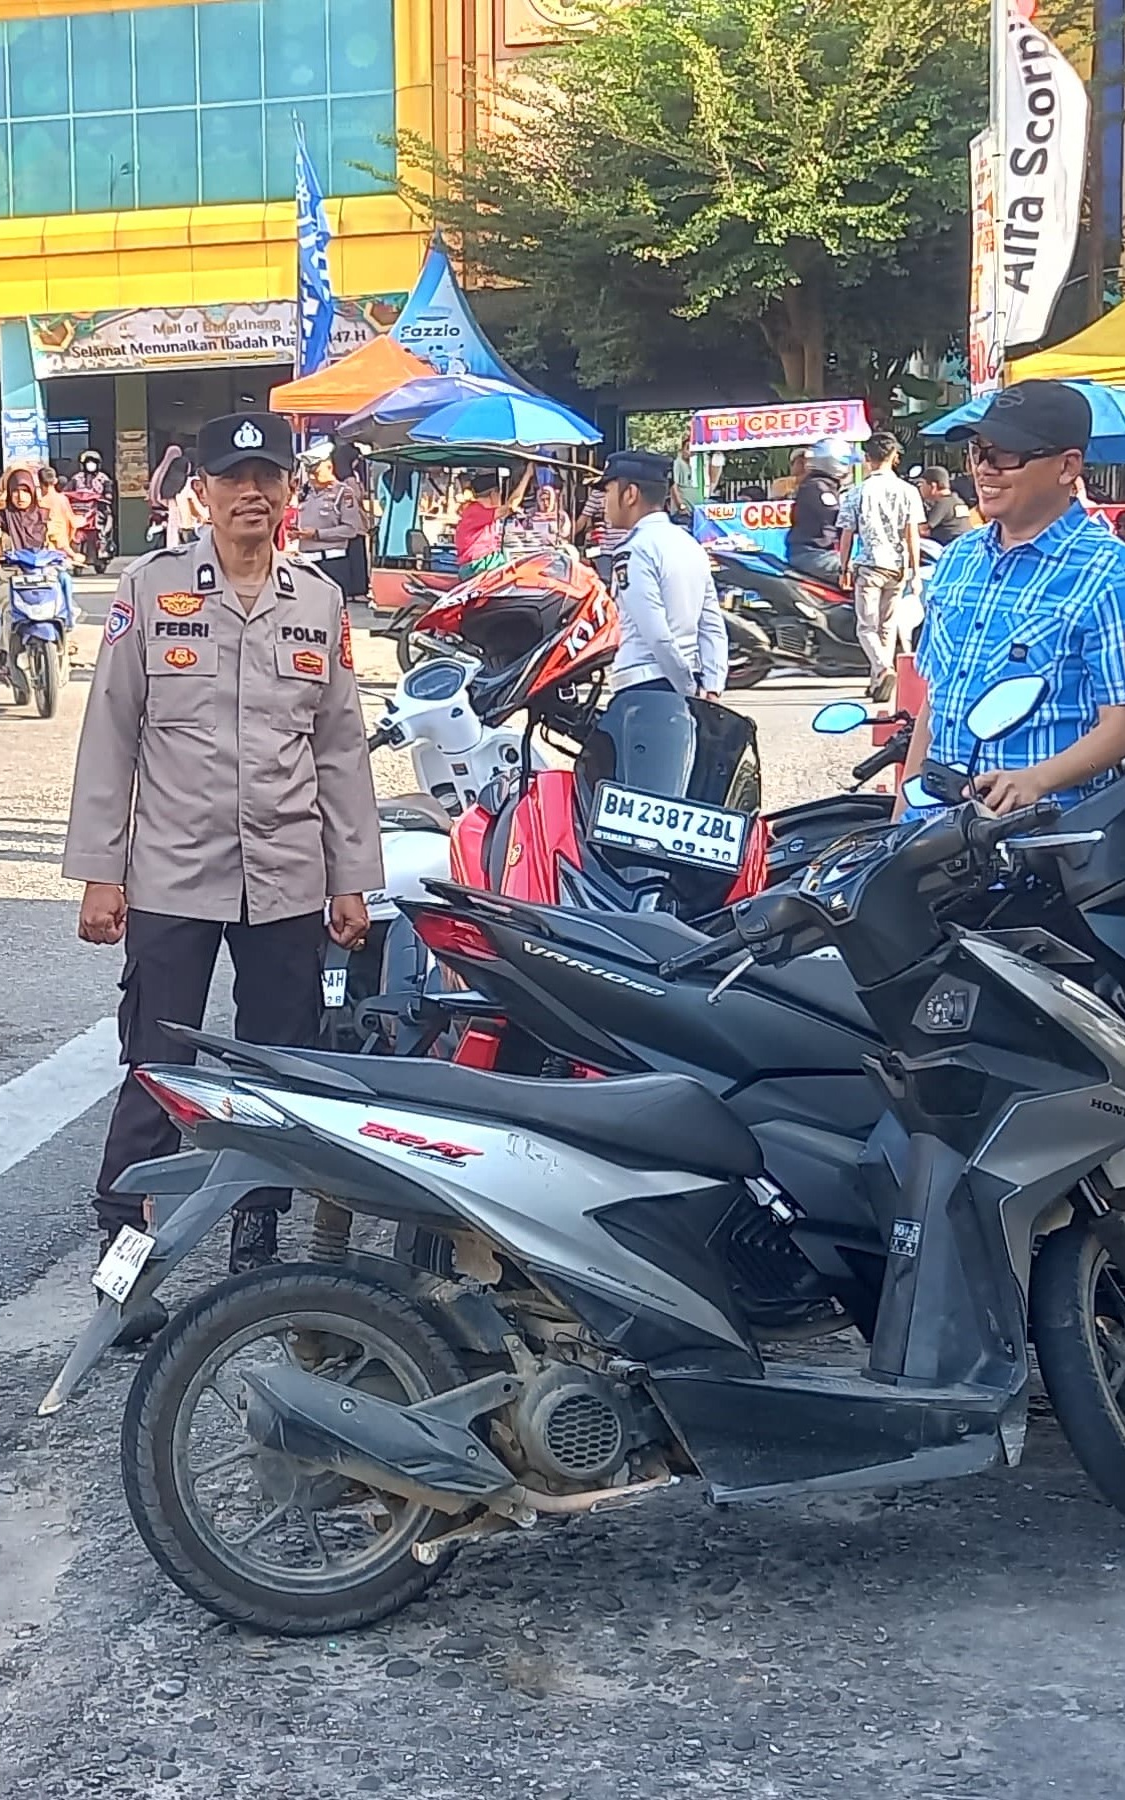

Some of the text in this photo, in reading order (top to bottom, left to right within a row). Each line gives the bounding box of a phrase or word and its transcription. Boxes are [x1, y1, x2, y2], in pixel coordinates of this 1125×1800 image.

[185, 321, 199, 334] of
[400, 323, 461, 338] Fazzio
[72, 344, 127, 359] Selamat
[130, 339, 217, 355] Menunaikan
[221, 335, 268, 350] Ibadah
[709, 409, 842, 432] NEW CREPES
[707, 505, 735, 518] NEW
[155, 621, 328, 645] FEBRI POLRI
[604, 793, 736, 842] BM 2387 ZBL
[523, 941, 630, 984] VARIO
[1090, 1098, 1125, 1118] HON
